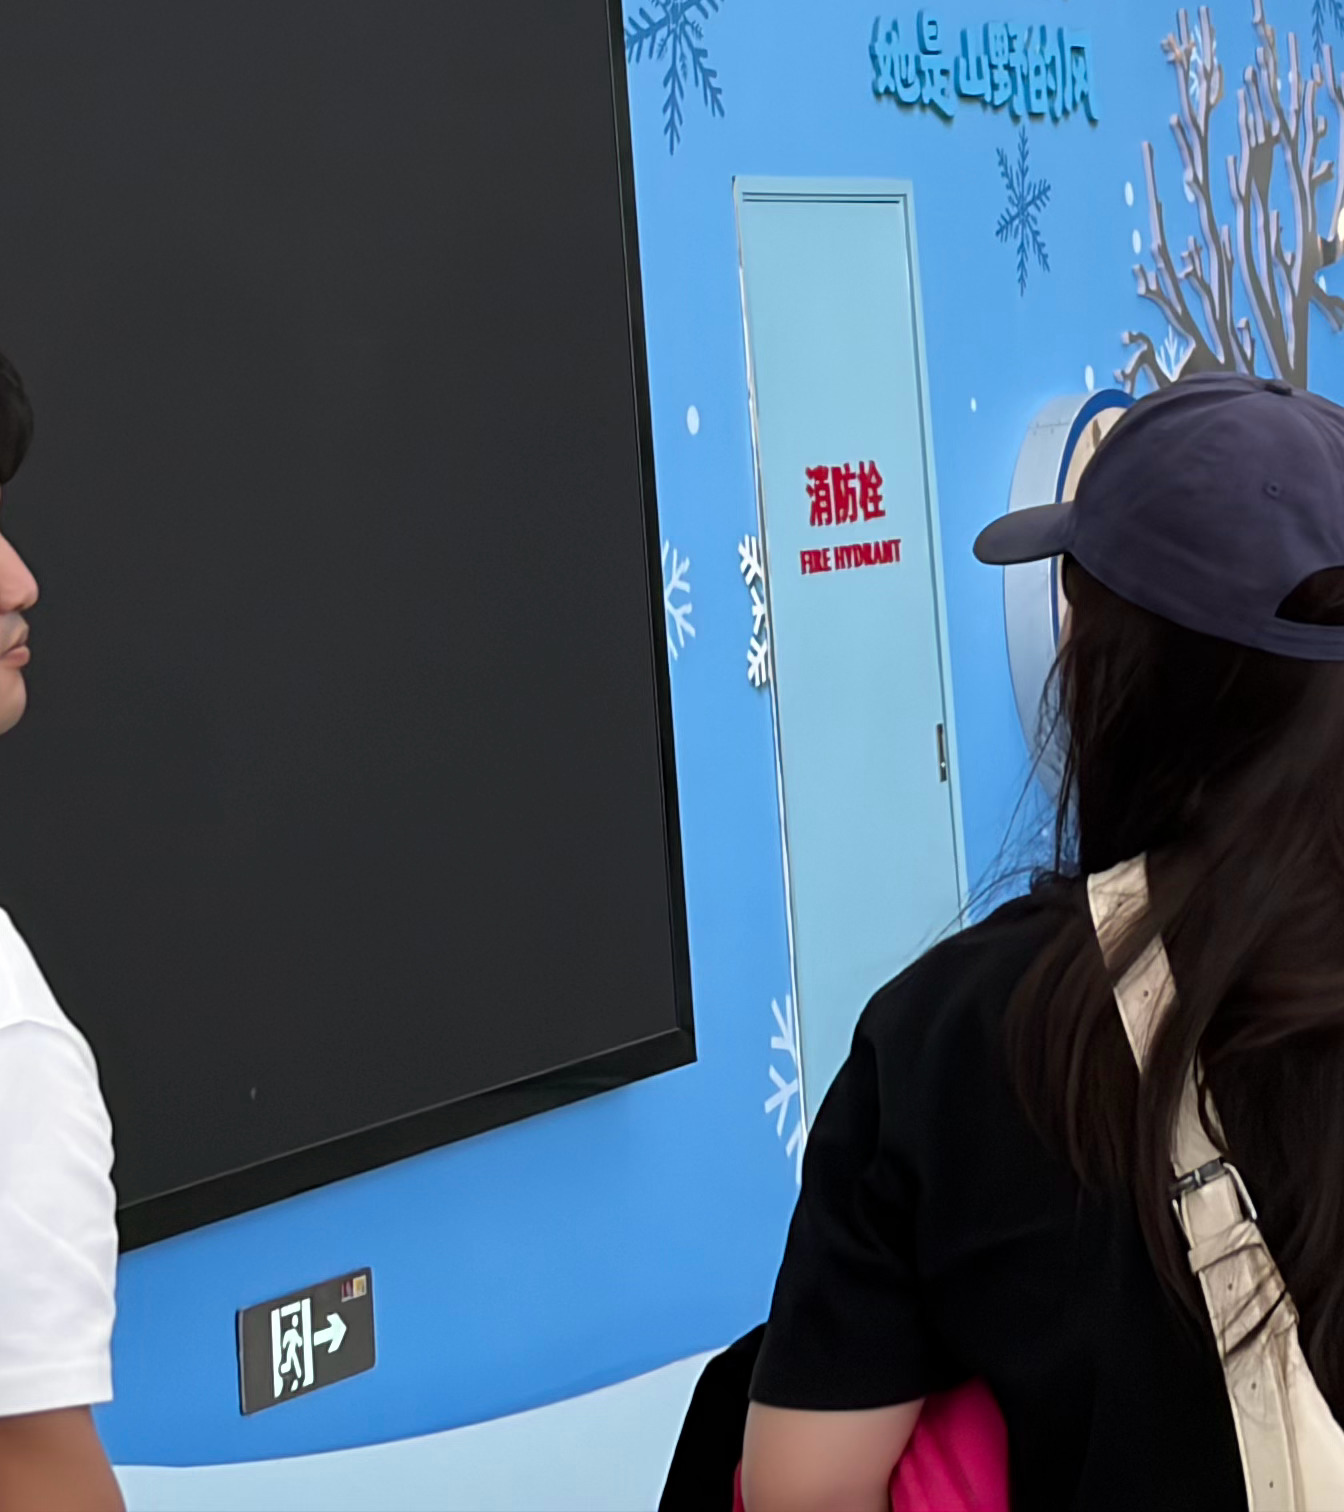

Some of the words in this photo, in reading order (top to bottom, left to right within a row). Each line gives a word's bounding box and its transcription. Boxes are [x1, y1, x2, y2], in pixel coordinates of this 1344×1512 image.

[869, 8, 1099, 122] 她是山野的风
[805, 459, 886, 527] 消防栓
[800, 547, 832, 575] FIRE
[833, 538, 902, 571] HYDRANT
